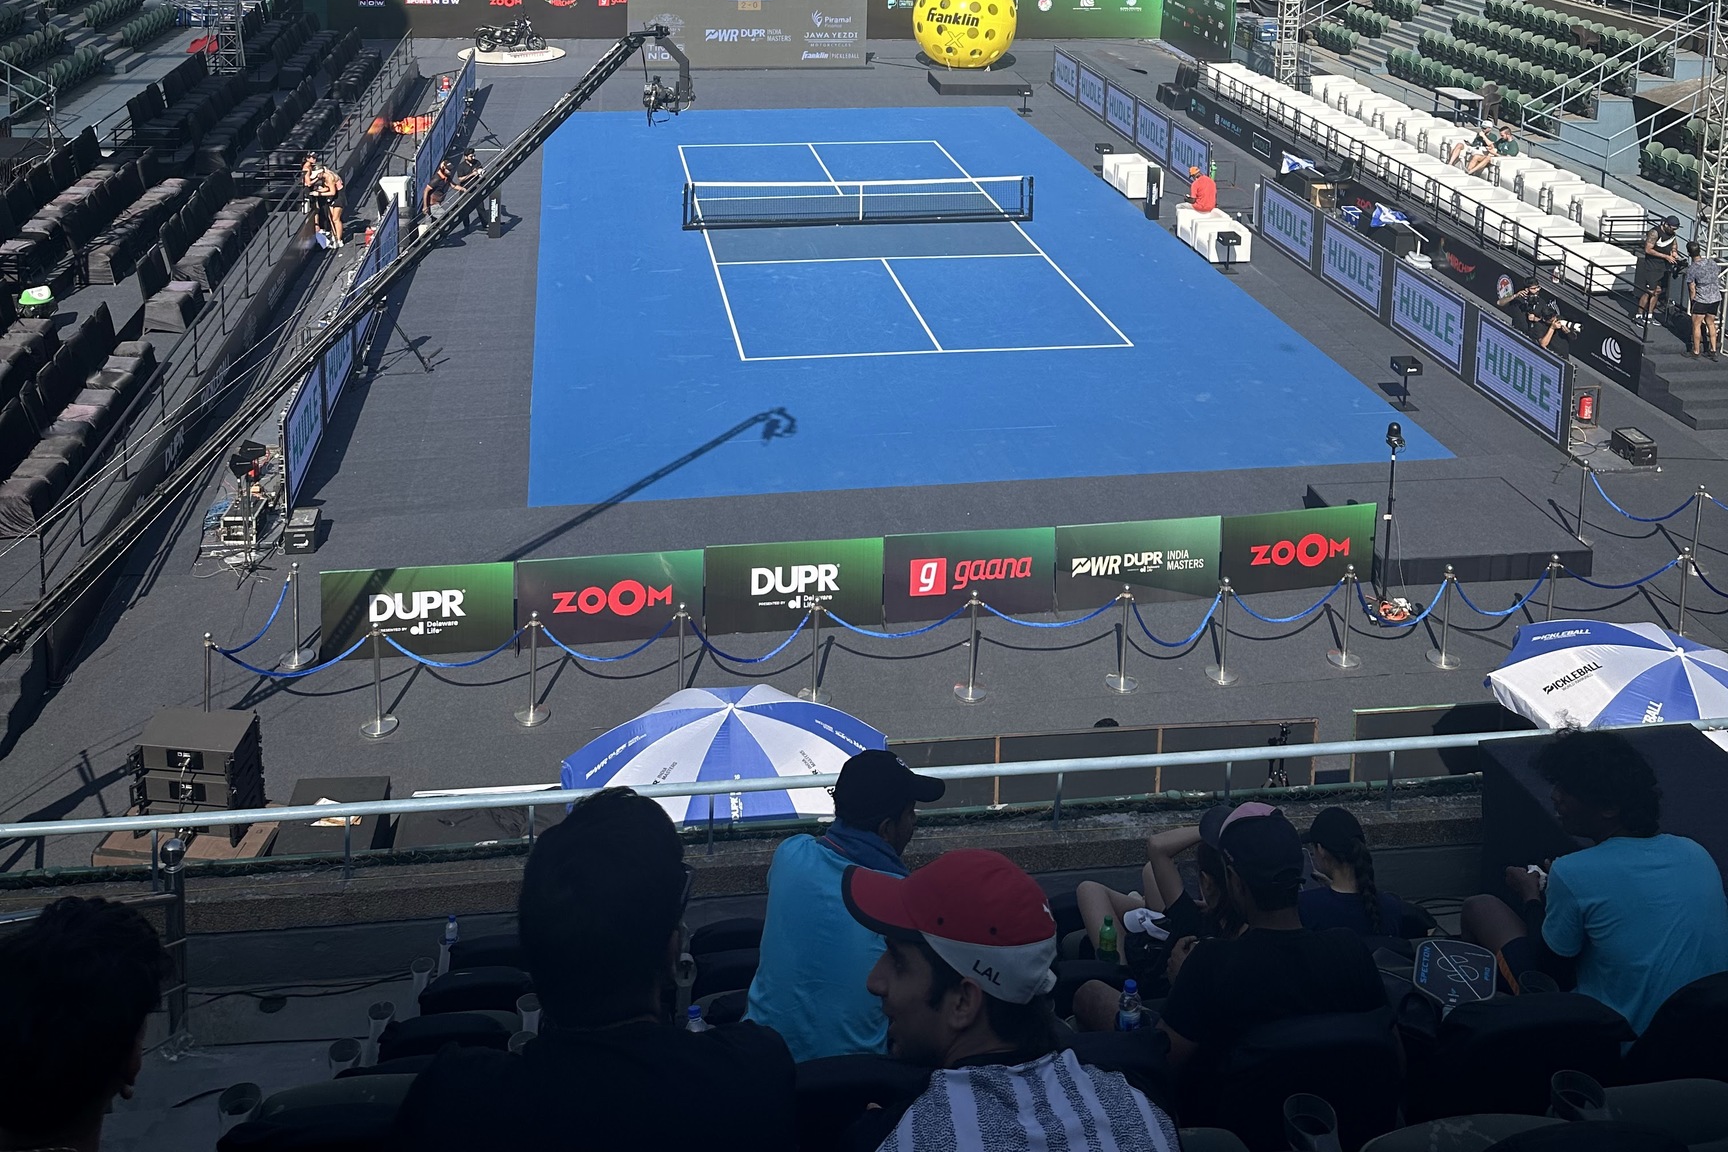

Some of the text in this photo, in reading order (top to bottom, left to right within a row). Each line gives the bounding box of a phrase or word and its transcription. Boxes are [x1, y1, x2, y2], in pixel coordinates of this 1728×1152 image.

[741, 29, 766, 38] DUPR
[1056, 58, 1075, 88] HUDLE
[1081, 75, 1101, 106] HUDLE
[1109, 94, 1131, 127] HUDLE
[1139, 115, 1165, 149] HUDLE
[1267, 198, 1307, 248] HUDLE
[1328, 237, 1375, 292] HUDLE
[1399, 282, 1455, 346] HUDLE
[1485, 338, 1552, 413] HUDLE
[291, 385, 319, 471] HUDLE
[165, 425, 185, 472] DUPR
[1123, 551, 1163, 567] DUPR
[1167, 549, 1189, 560] INDIA
[1167, 558, 1204, 571] MASTERS
[1250, 533, 1350, 567] ZOOM
[751, 563, 840, 596] DUPR
[952, 556, 1032, 590] gaana
[369, 589, 466, 622] DUPR
[552, 579, 673, 617] ZOOM
[426, 620, 459, 628] Delaware
[1531, 628, 1591, 641] PICKLEBALL
[1542, 661, 1603, 695] PICKLEBALL
[657, 767, 667, 779] INDIA
[662, 761, 678, 780] MASTERS
[972, 959, 1001, 986] LAL
